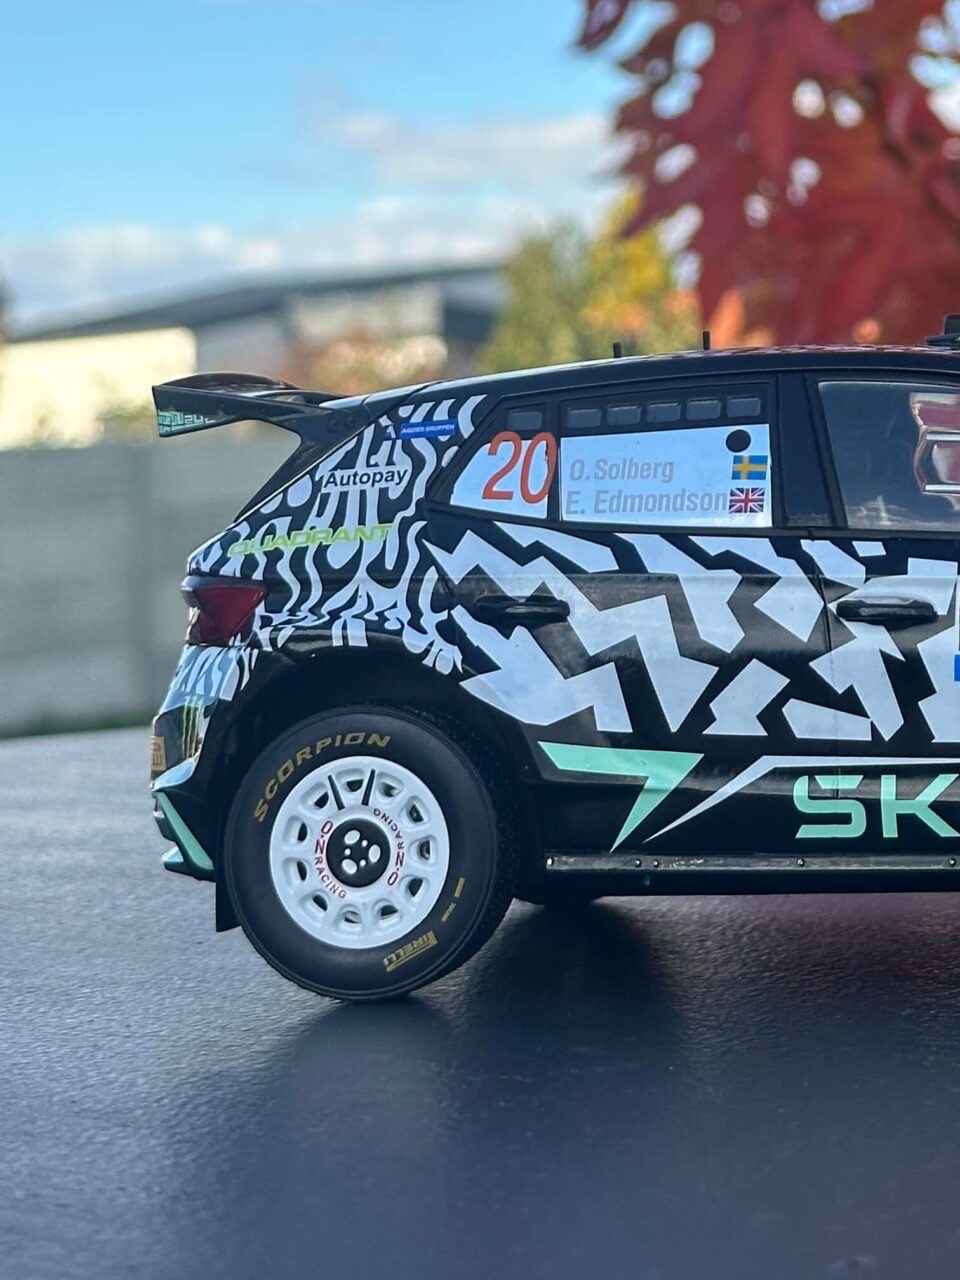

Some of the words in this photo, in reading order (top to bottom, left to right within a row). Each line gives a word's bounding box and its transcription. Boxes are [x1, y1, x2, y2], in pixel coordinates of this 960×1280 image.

[324, 469, 408, 489] Autopay
[481, 431, 558, 504] 20
[594, 459, 675, 483] Solberg
[565, 491, 585, 515] E.
[594, 488, 727, 514] Edmondson
[227, 523, 393, 557] QUADRANT
[254, 732, 391, 822] SCORPION
[384, 930, 438, 972] PIRELLI
